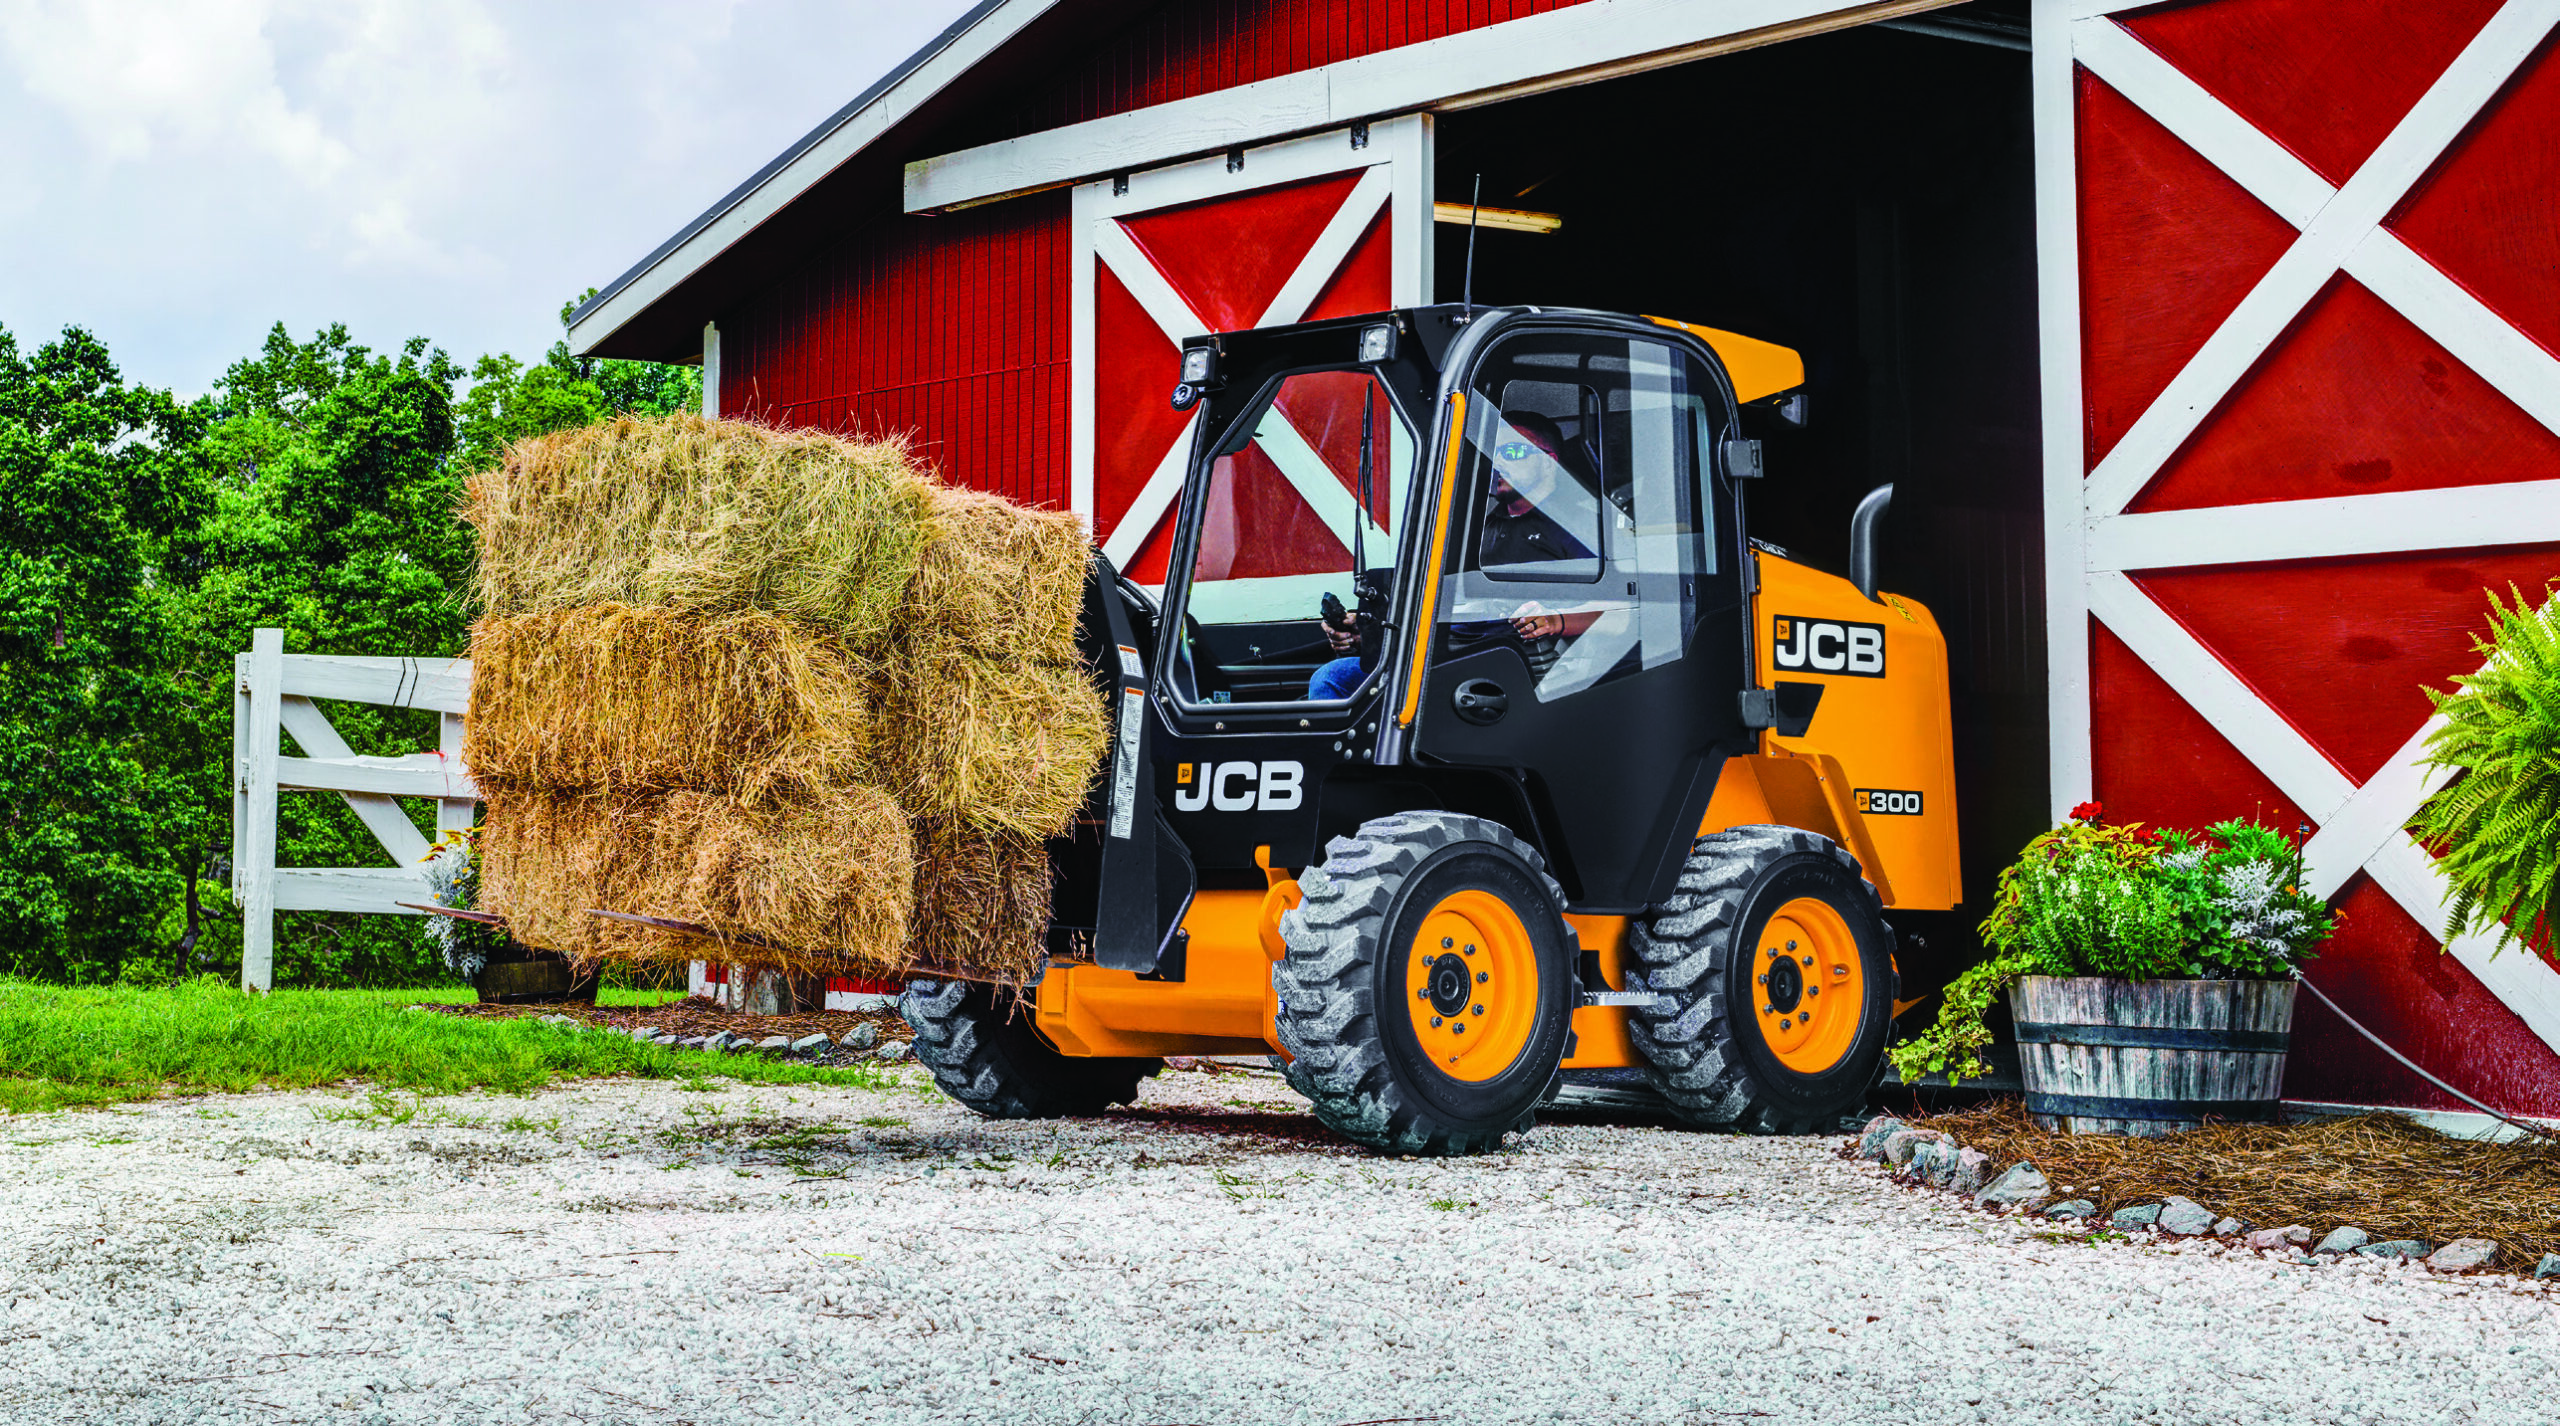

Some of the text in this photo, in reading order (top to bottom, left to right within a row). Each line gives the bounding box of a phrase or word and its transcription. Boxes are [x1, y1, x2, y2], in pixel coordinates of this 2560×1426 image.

[1776, 621, 1883, 674] JCB
[1175, 761, 1304, 812] JCB
[1870, 791, 1920, 814] 300
